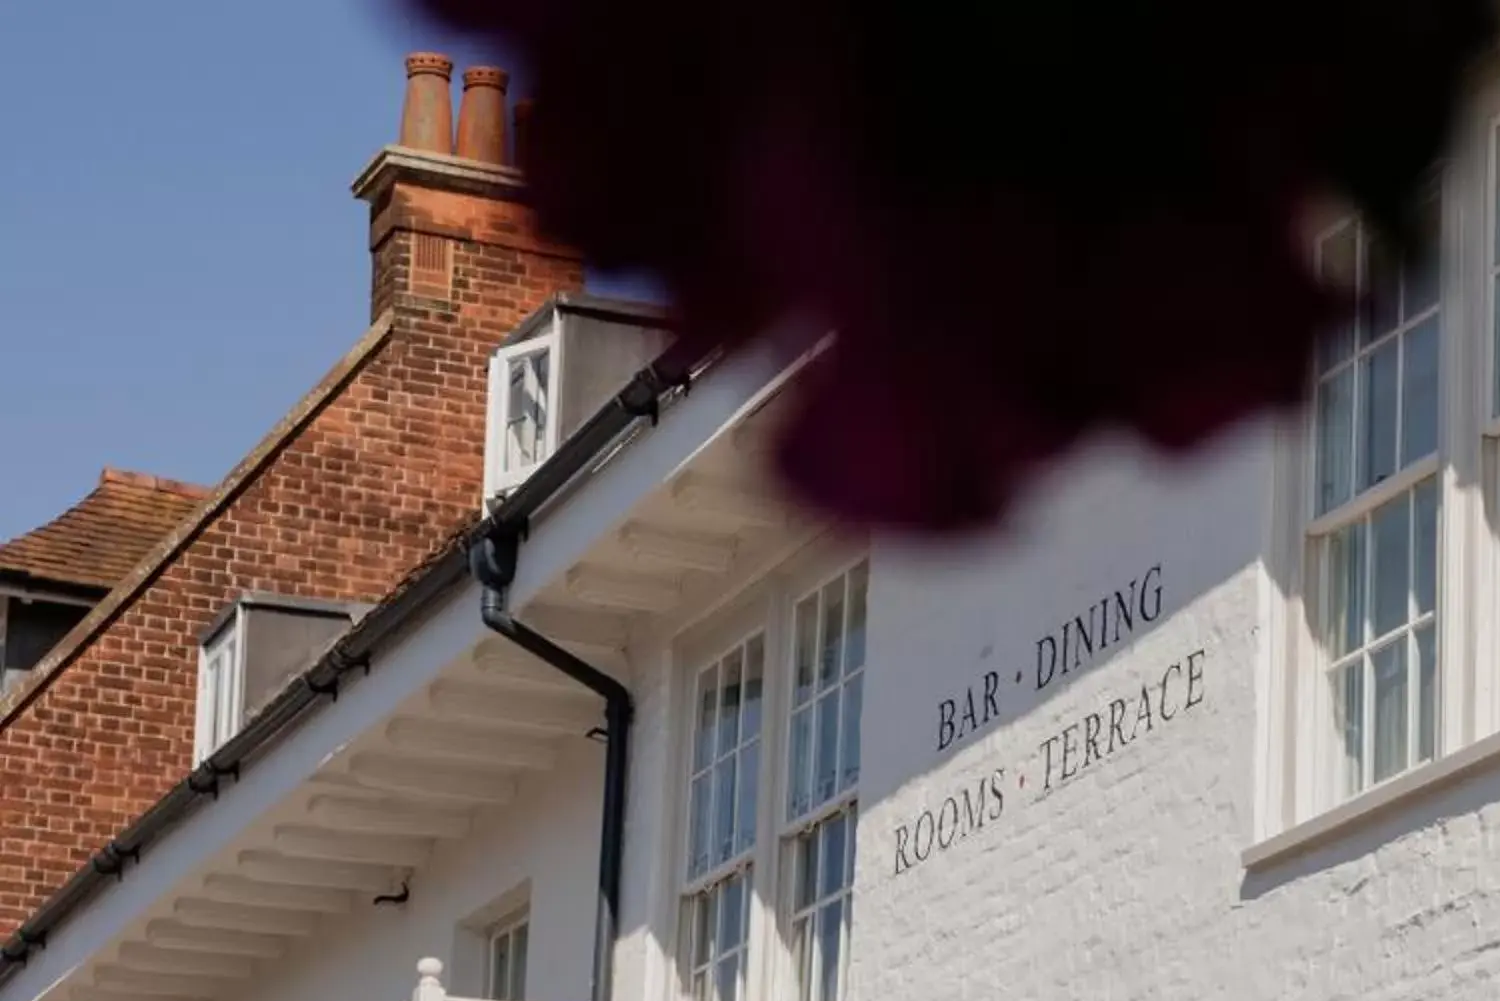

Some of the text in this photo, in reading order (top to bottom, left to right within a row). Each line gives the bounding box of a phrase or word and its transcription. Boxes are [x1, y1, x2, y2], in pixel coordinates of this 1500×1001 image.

[937, 563, 1162, 751] BAR DINING
[894, 650, 1206, 875] ROOMS TERRACE
